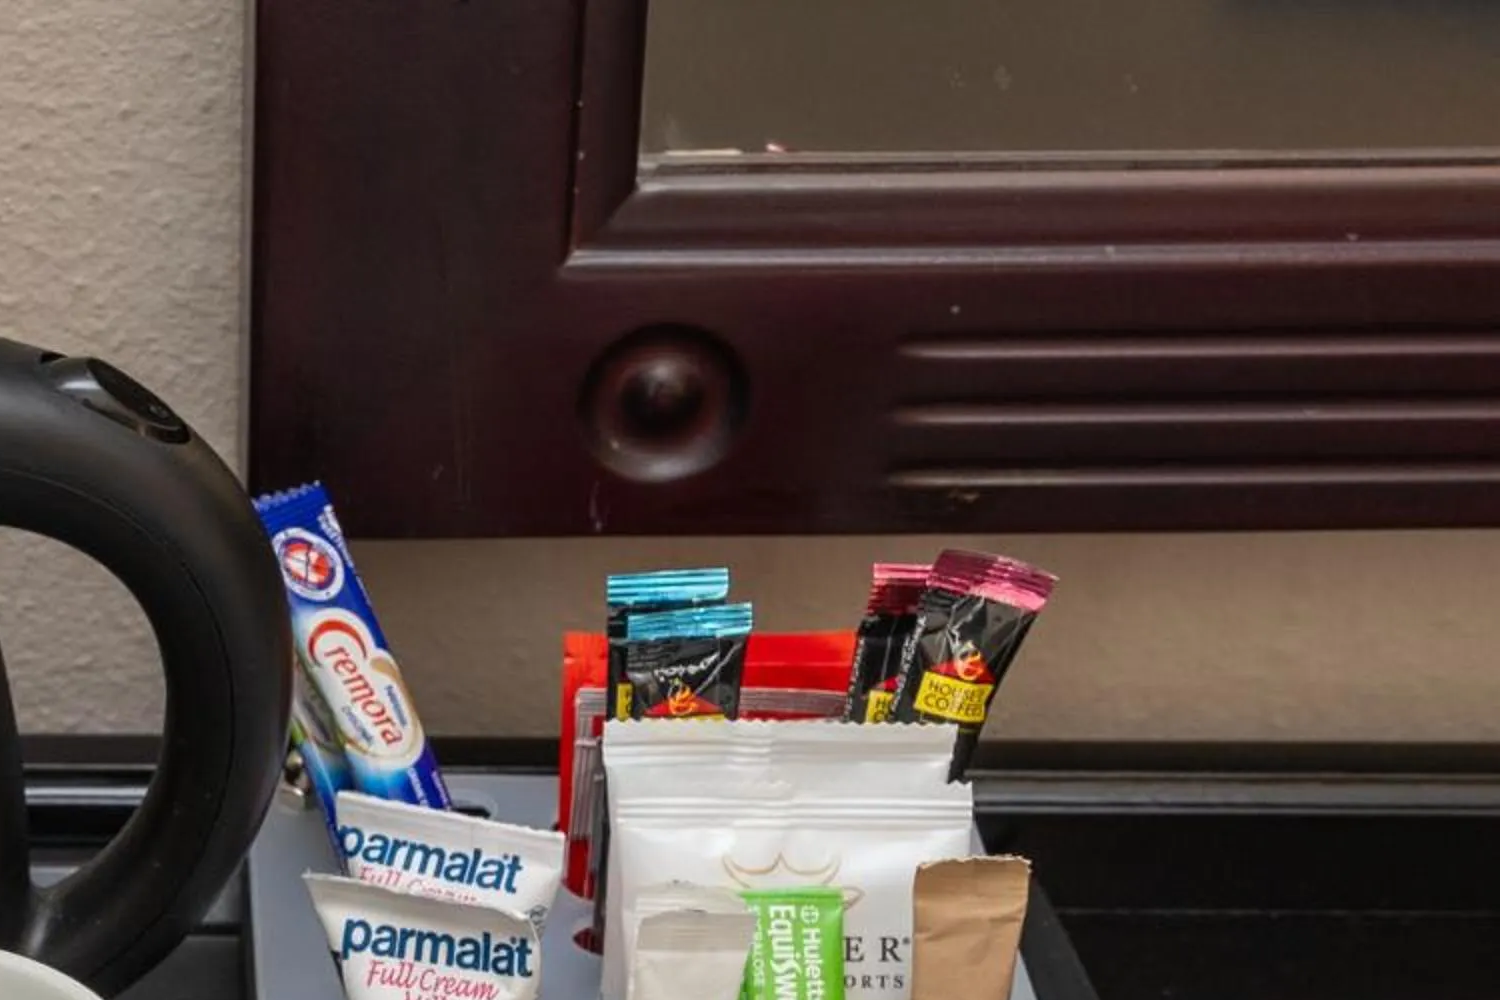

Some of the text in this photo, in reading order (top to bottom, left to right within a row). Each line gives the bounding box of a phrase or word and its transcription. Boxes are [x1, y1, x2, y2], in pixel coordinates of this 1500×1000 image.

[307, 618, 404, 745] Cremora
[339, 825, 523, 894] parmalat
[341, 917, 533, 978] parmalat
[366, 958, 500, 1000] Full Cream
